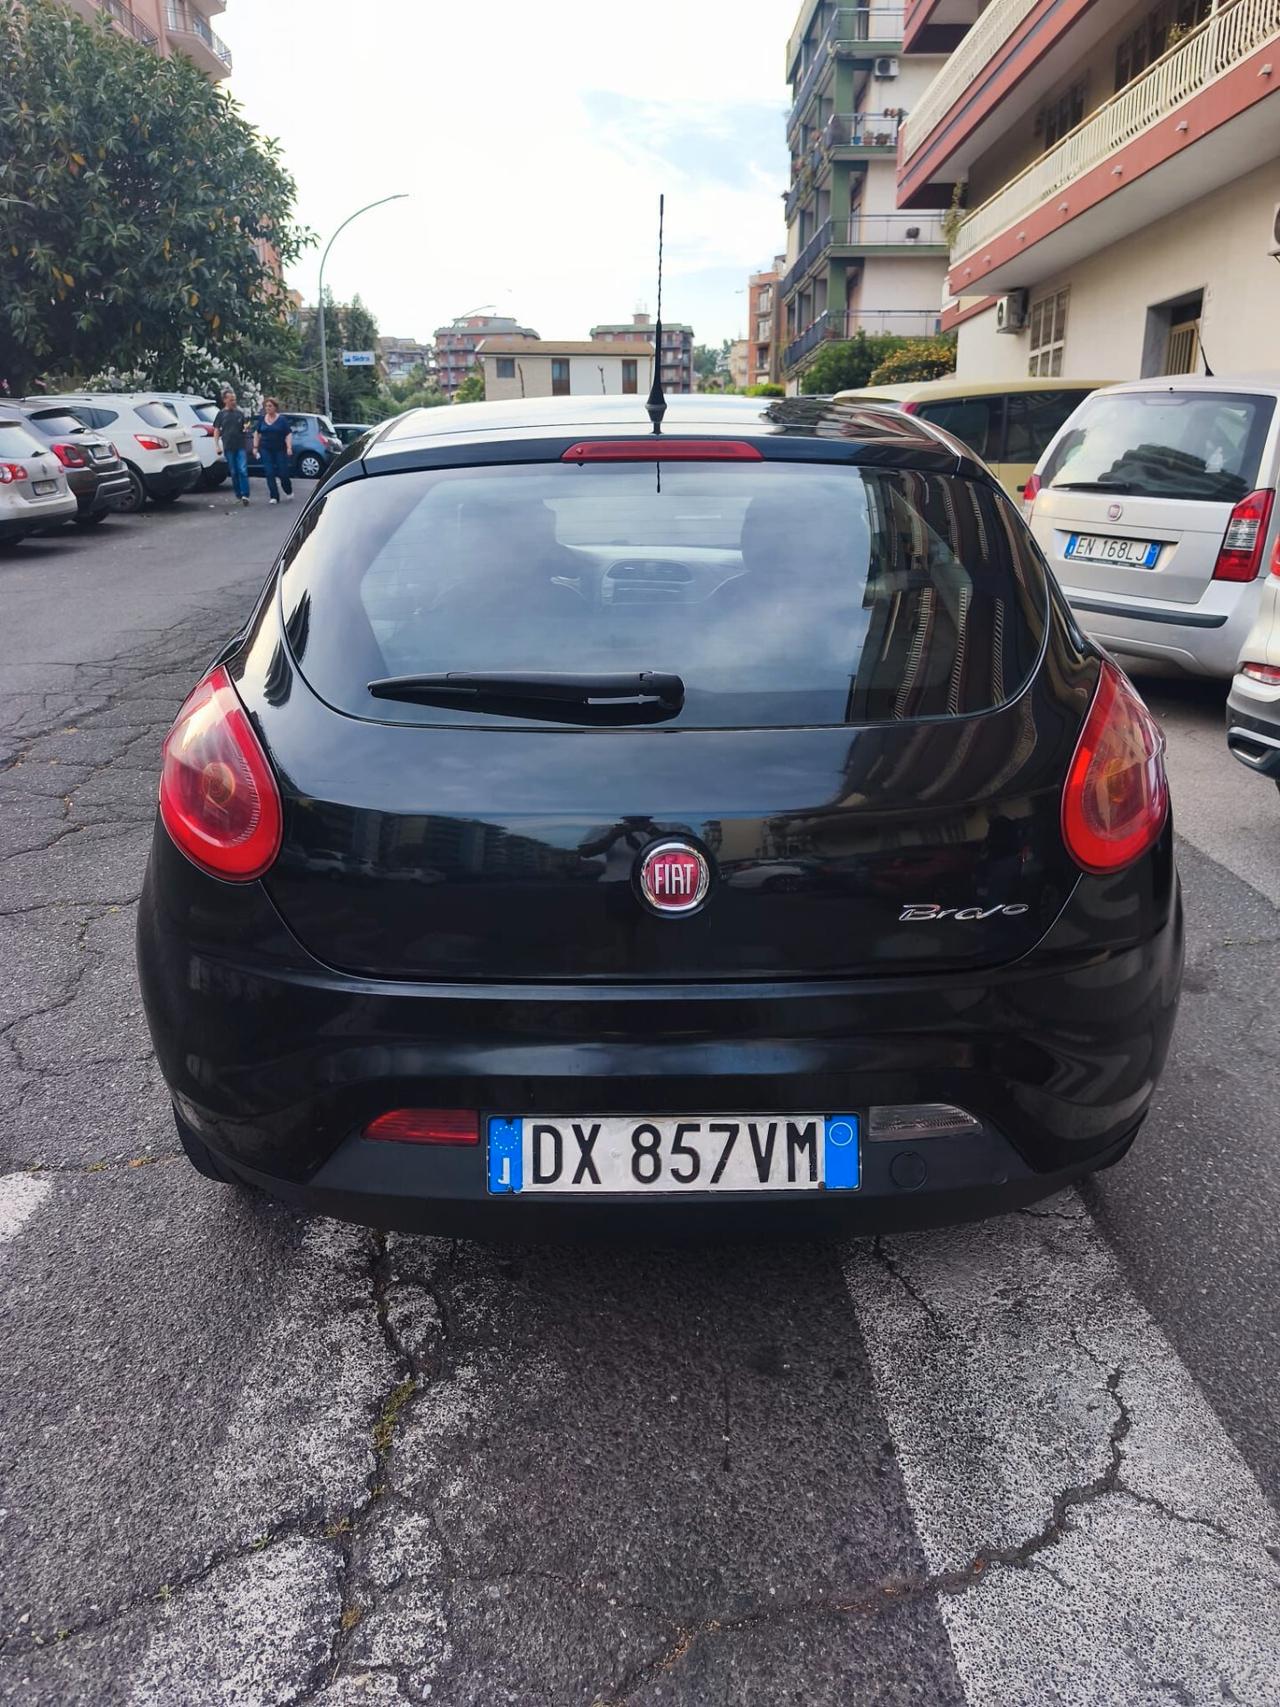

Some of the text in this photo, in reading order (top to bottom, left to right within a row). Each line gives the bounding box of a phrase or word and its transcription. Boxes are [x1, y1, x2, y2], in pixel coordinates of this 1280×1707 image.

[1076, 537, 1096, 555] EN
[1101, 540, 1148, 561] 168LJ
[654, 863, 694, 895] FIAT
[899, 903, 1029, 921] Bravo
[532, 1123, 602, 1185] DX
[631, 1121, 818, 1184] 857VM
